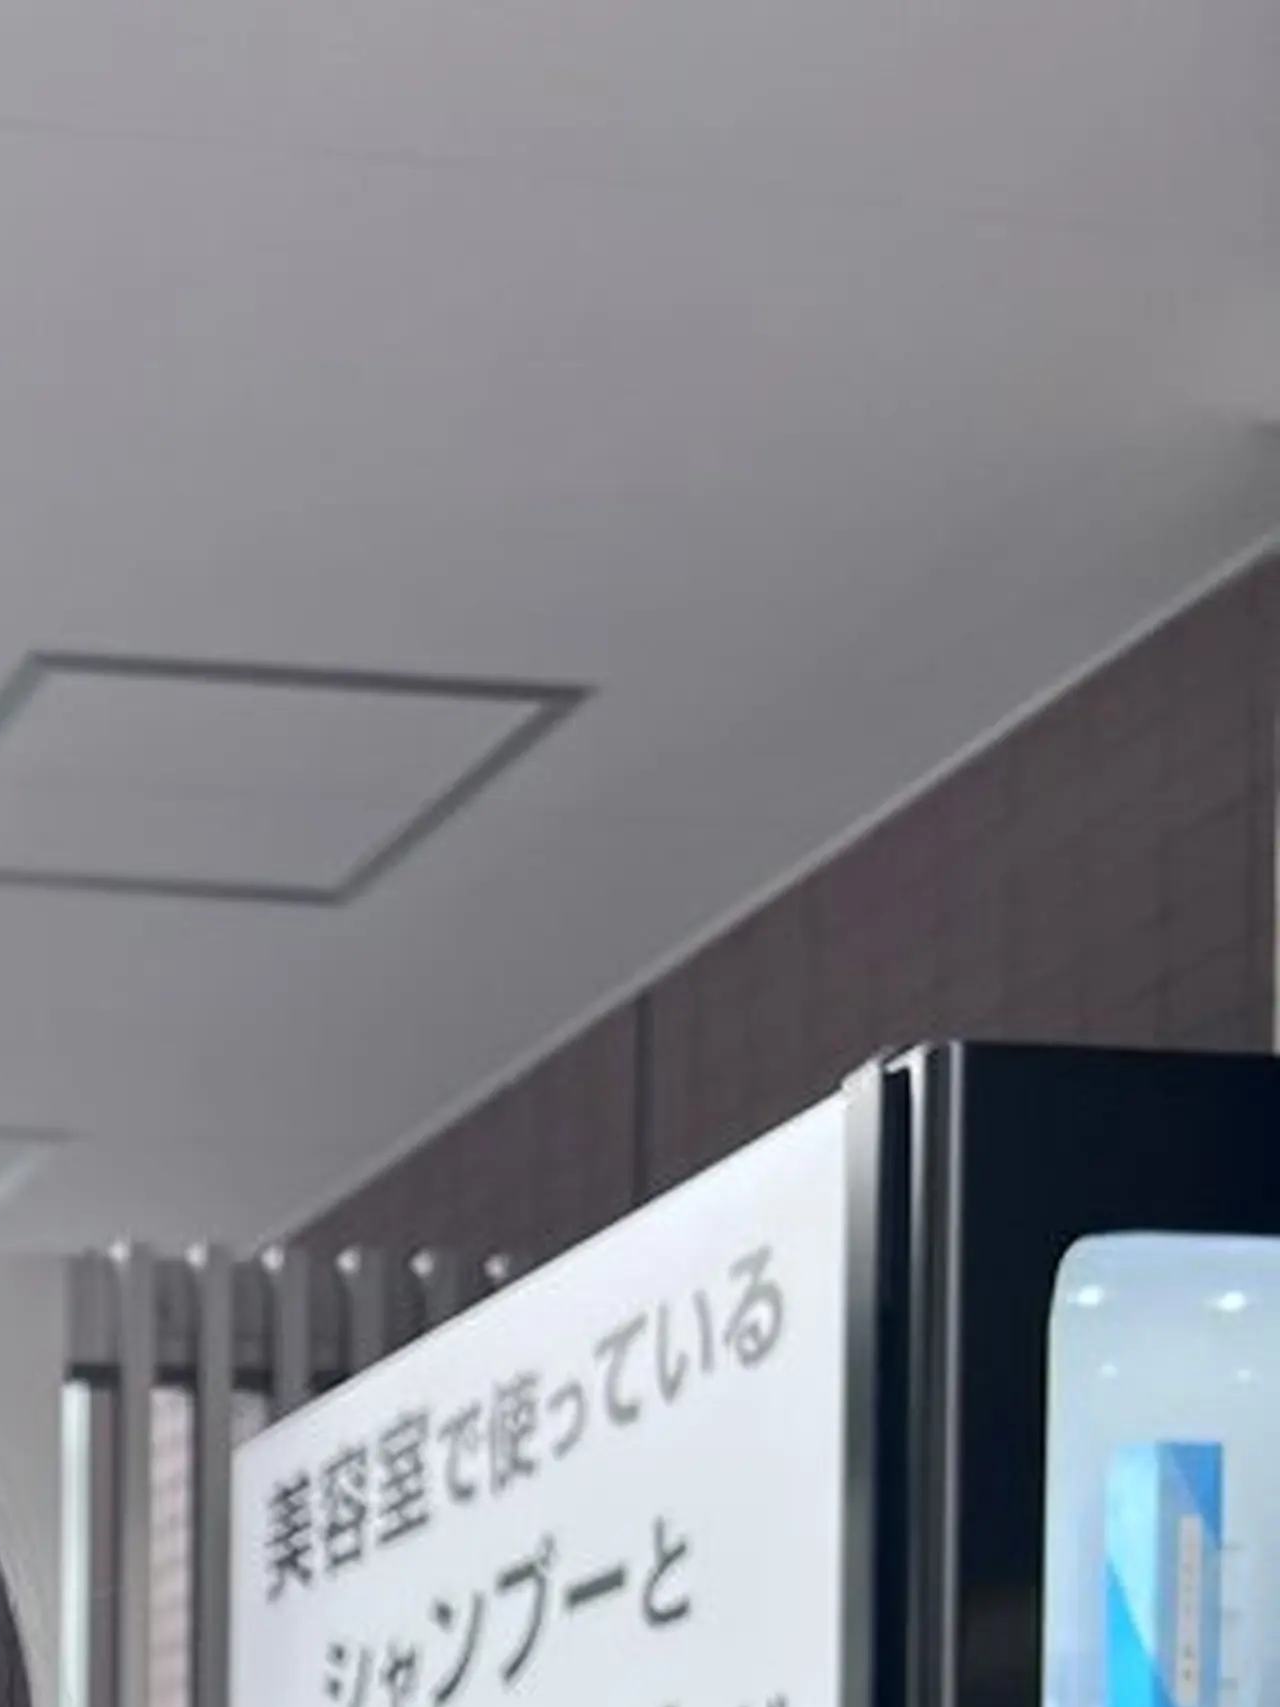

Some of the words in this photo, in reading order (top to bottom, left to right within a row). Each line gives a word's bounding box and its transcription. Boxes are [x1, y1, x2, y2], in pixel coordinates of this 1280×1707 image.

[266, 1246, 785, 1602] 美容室で使っている
